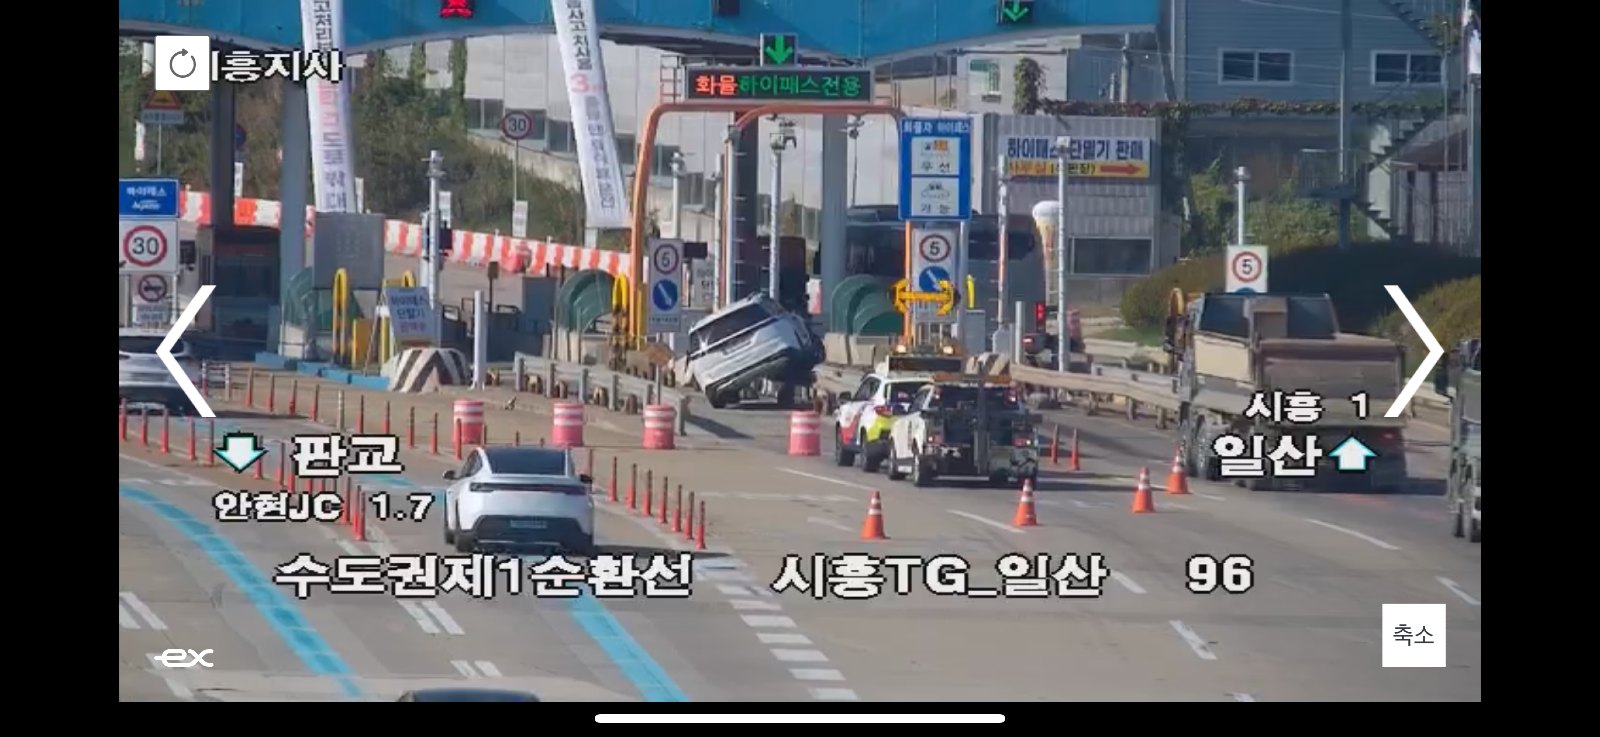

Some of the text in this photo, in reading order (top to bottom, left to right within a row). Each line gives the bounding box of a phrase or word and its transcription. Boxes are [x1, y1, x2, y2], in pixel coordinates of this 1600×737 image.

[508, 116, 526, 132] 30
[1070, 138, 1110, 160] 단말기
[1117, 139, 1144, 160] 판매
[132, 236, 160, 256] 30
[930, 240, 940, 256] 5
[1242, 258, 1253, 275] 5
